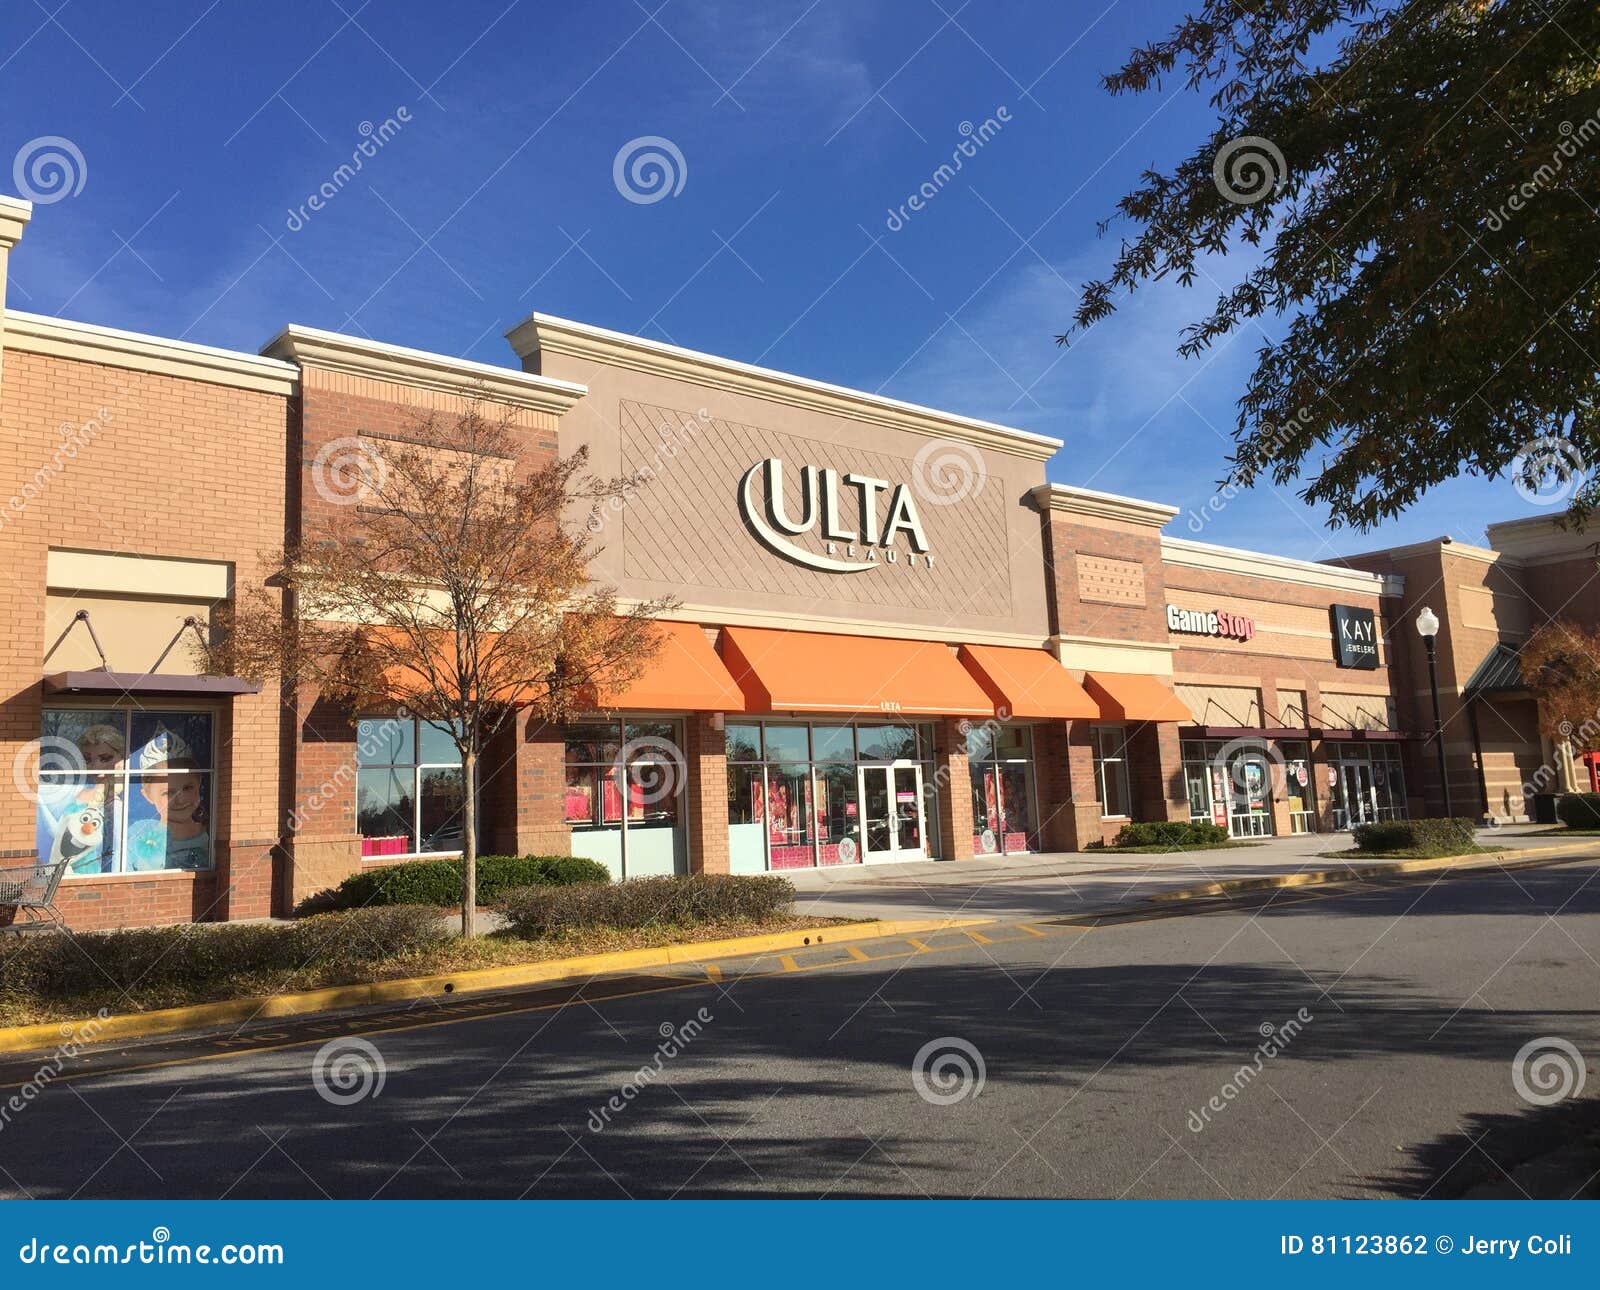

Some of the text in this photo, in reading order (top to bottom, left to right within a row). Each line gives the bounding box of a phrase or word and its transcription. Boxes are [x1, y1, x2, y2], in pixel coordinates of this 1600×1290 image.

[763, 458, 930, 553] ULTA
[827, 541, 936, 568] BEAUTY
[1167, 604, 1256, 640] GameStop
[1340, 618, 1372, 641] KAY
[1345, 643, 1376, 655] JEWELERS
[880, 701, 901, 711] ULTA
